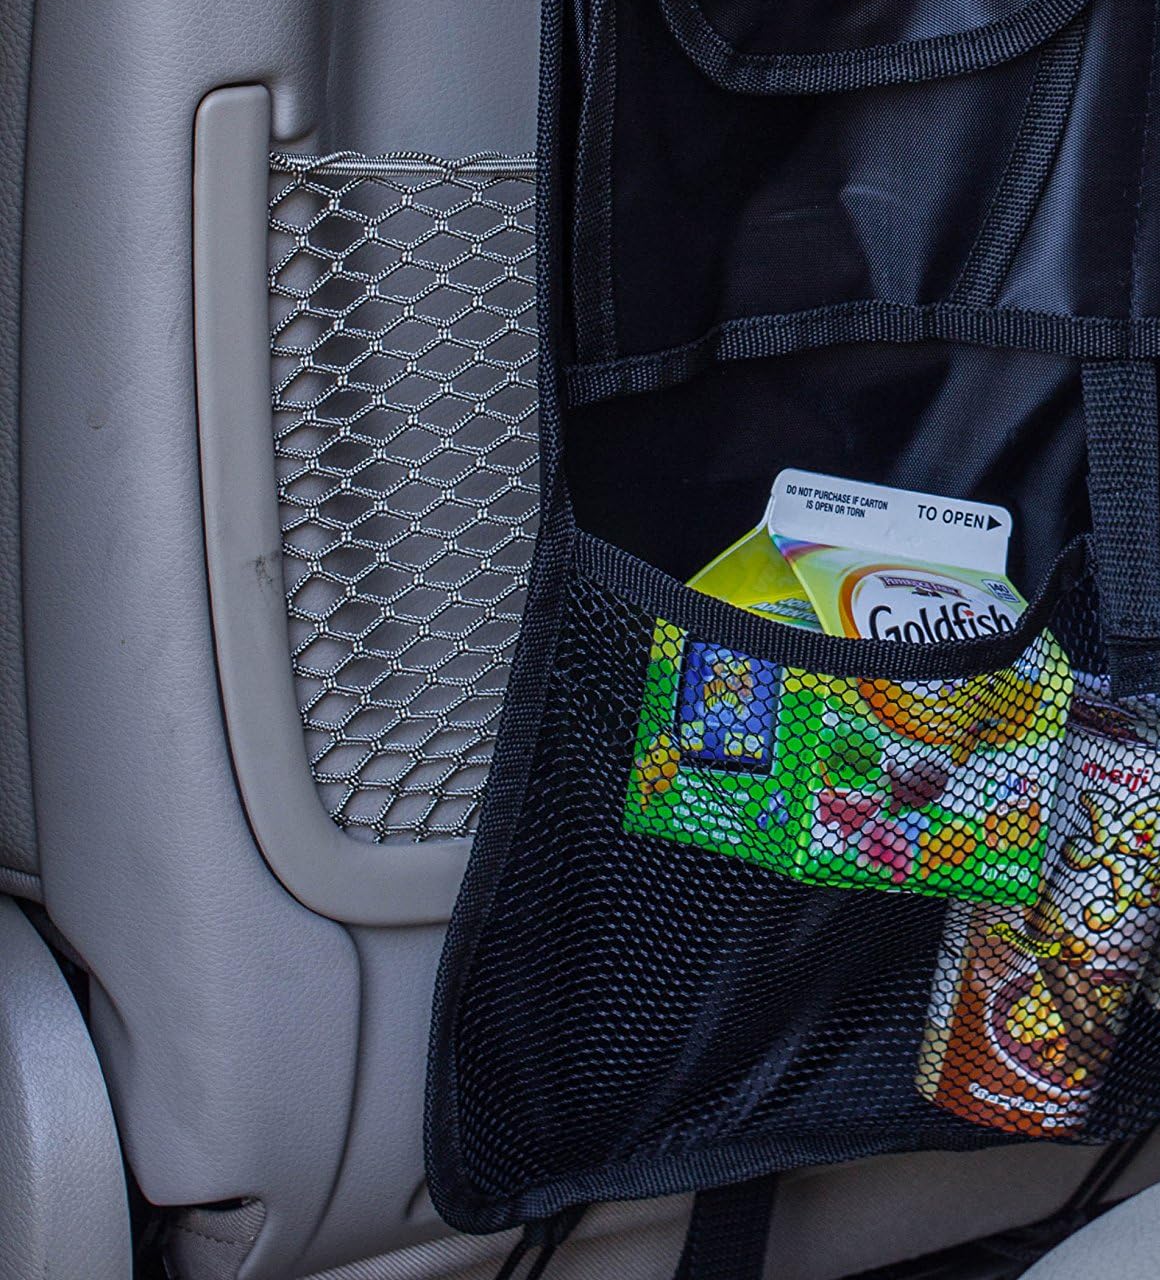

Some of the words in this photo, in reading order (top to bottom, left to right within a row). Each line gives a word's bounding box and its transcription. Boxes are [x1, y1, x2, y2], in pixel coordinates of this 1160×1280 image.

[786, 484, 797, 495] DO
[798, 486, 813, 498] NOT
[814, 489, 851, 505] PURCHASE
[852, 496, 859, 505] IF
[860, 498, 888, 510] CARTON
[805, 499, 814, 510] IS
[814, 501, 834, 513] OPEN
[834, 504, 845, 515] OR
[846, 506, 866, 518] TORN
[917, 505, 937, 520] TO
[942, 509, 984, 529] OPEN
[869, 601, 1014, 644] Goldfish
